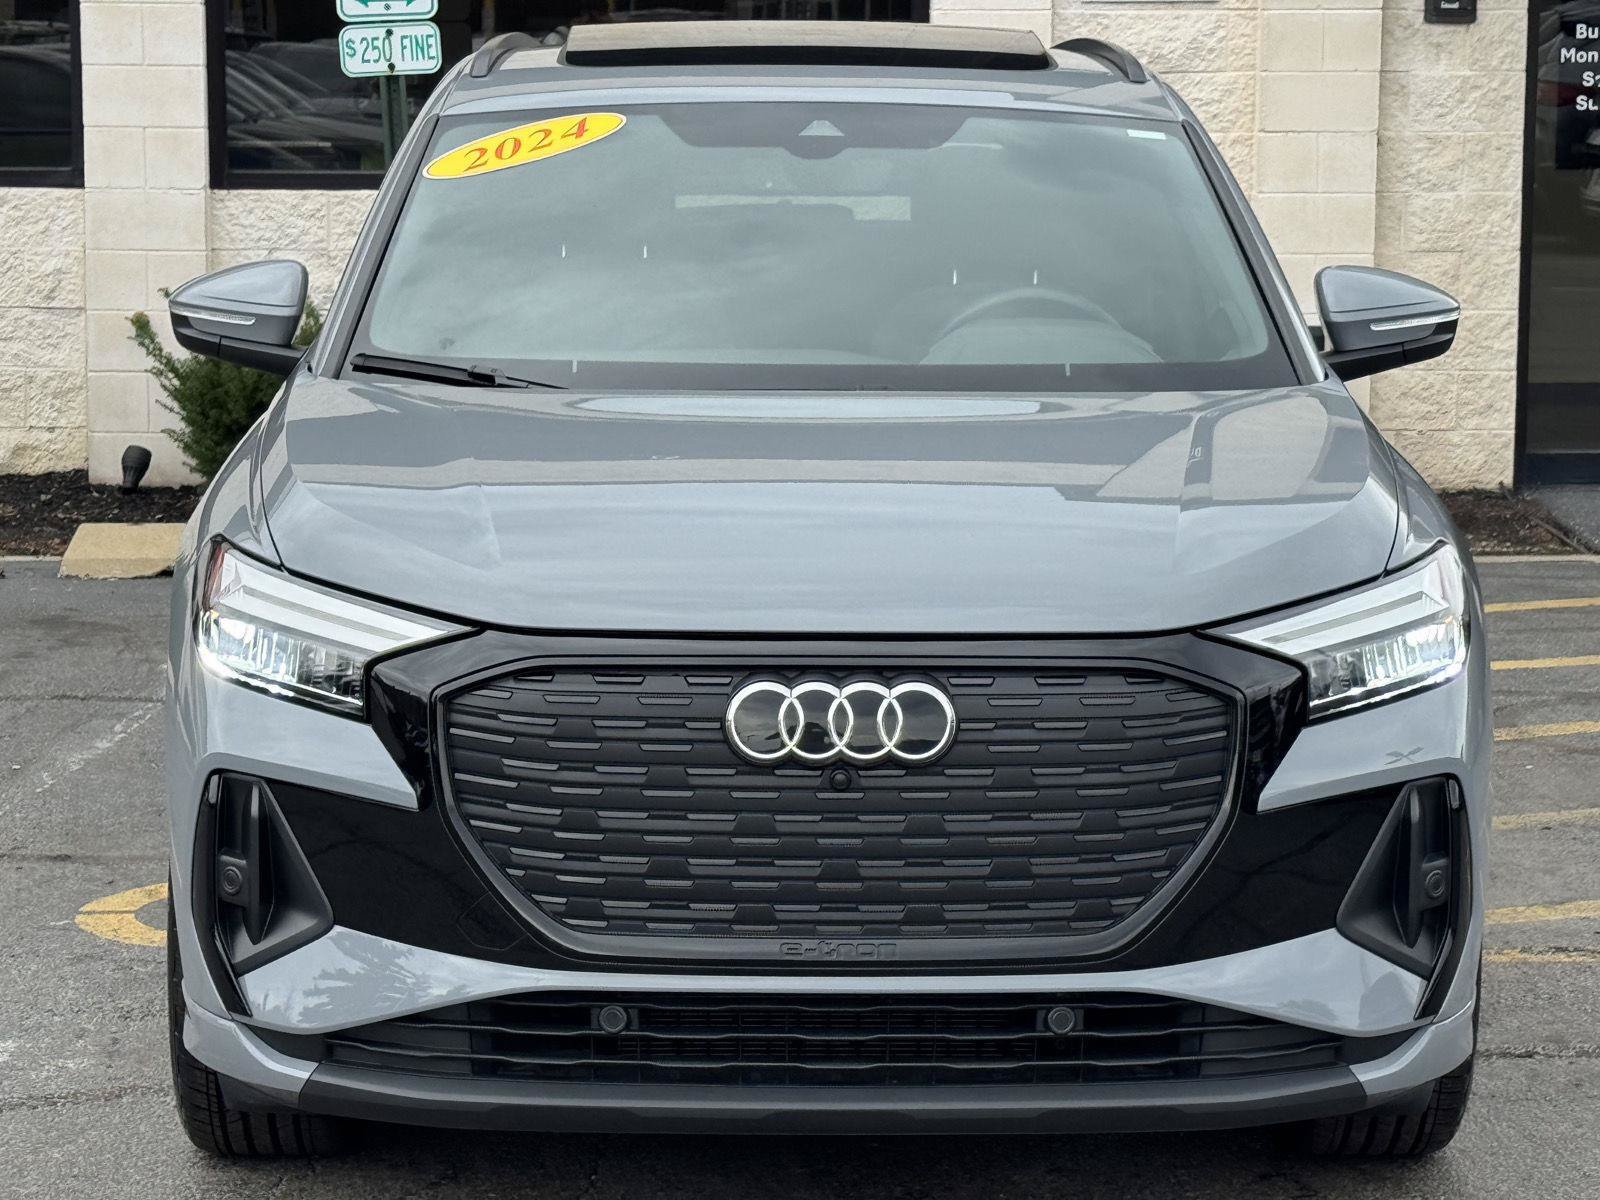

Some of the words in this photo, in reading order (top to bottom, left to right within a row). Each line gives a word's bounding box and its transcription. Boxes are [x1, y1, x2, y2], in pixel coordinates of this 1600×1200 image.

[1576, 23, 1599, 39] Bu
[345, 36, 393, 64] $250
[400, 34, 436, 62] FINE
[1560, 47, 1599, 63] Mon
[463, 116, 589, 172] 2024
[780, 939, 897, 959] e-tron
